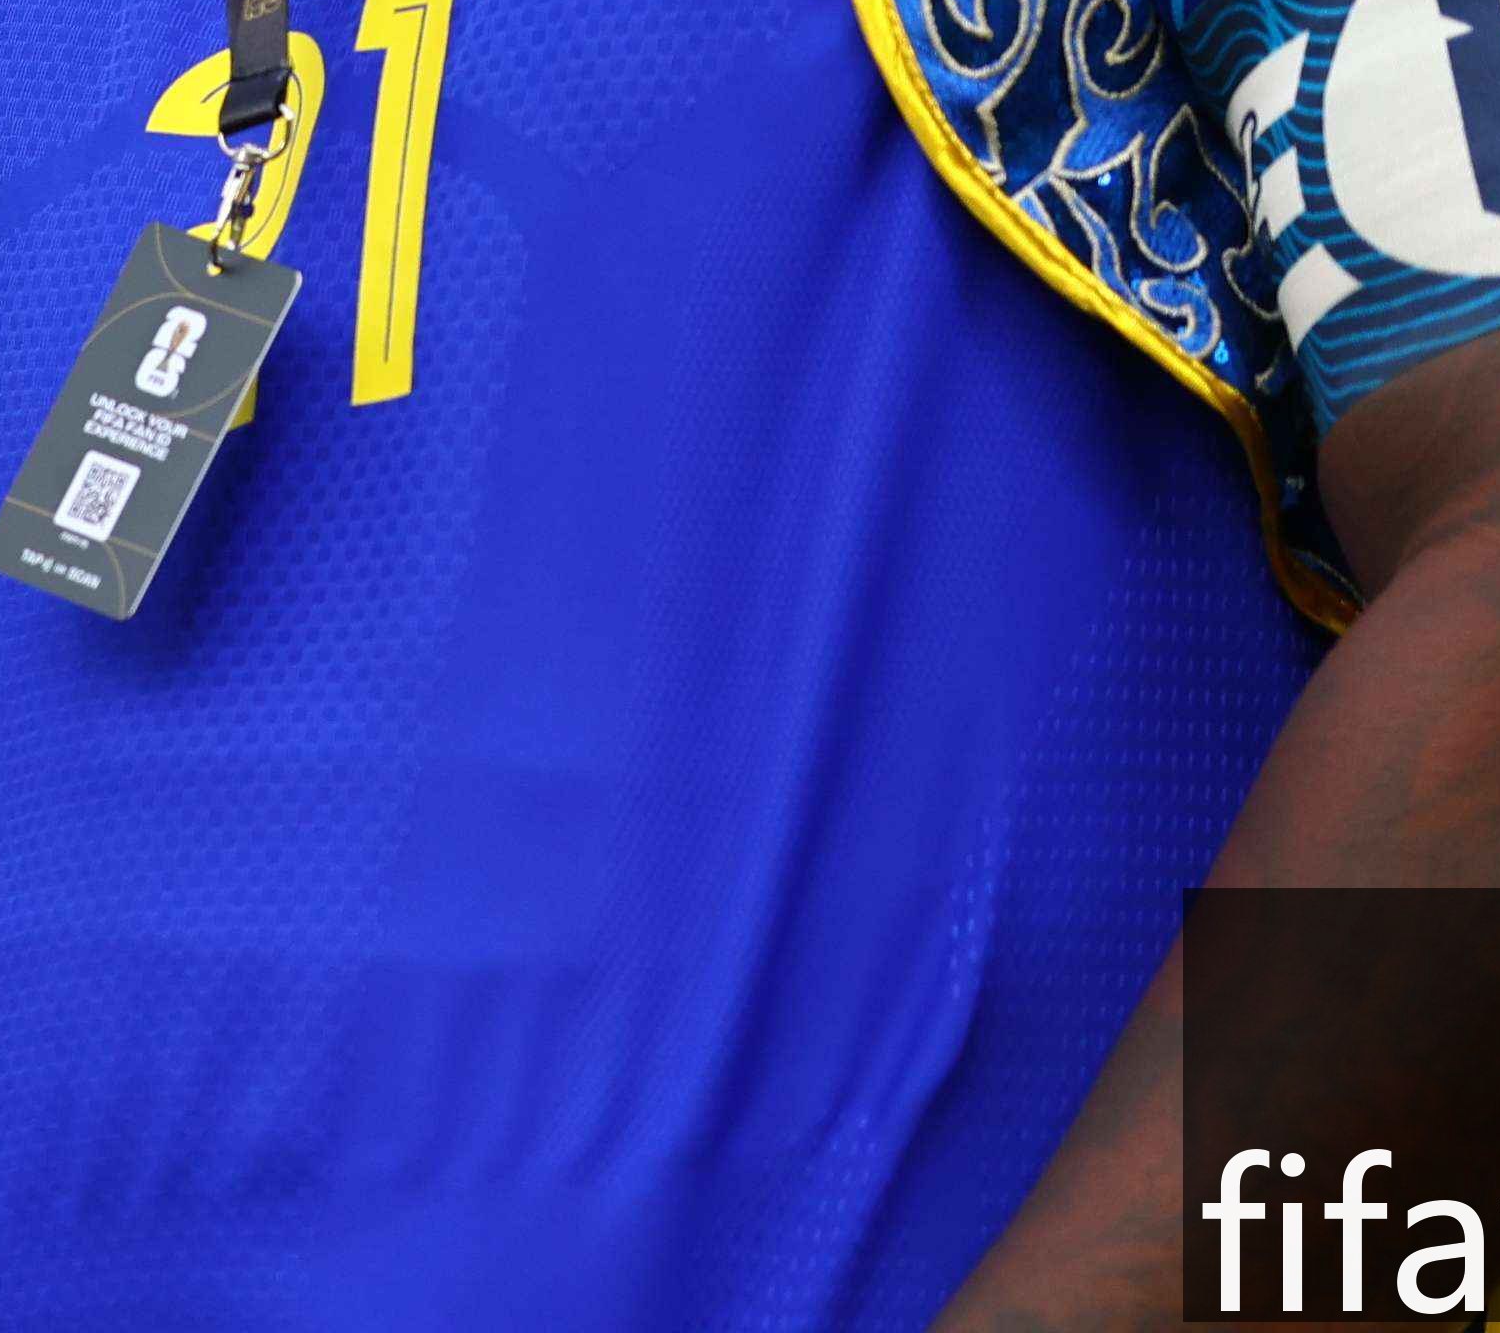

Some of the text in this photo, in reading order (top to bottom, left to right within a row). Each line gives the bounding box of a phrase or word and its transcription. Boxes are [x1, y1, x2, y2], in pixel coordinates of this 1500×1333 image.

[89, 391, 189, 440] UNLOCK YOUR
[93, 409, 124, 430] FIFA
[82, 419, 170, 462] EXPERIENCE
